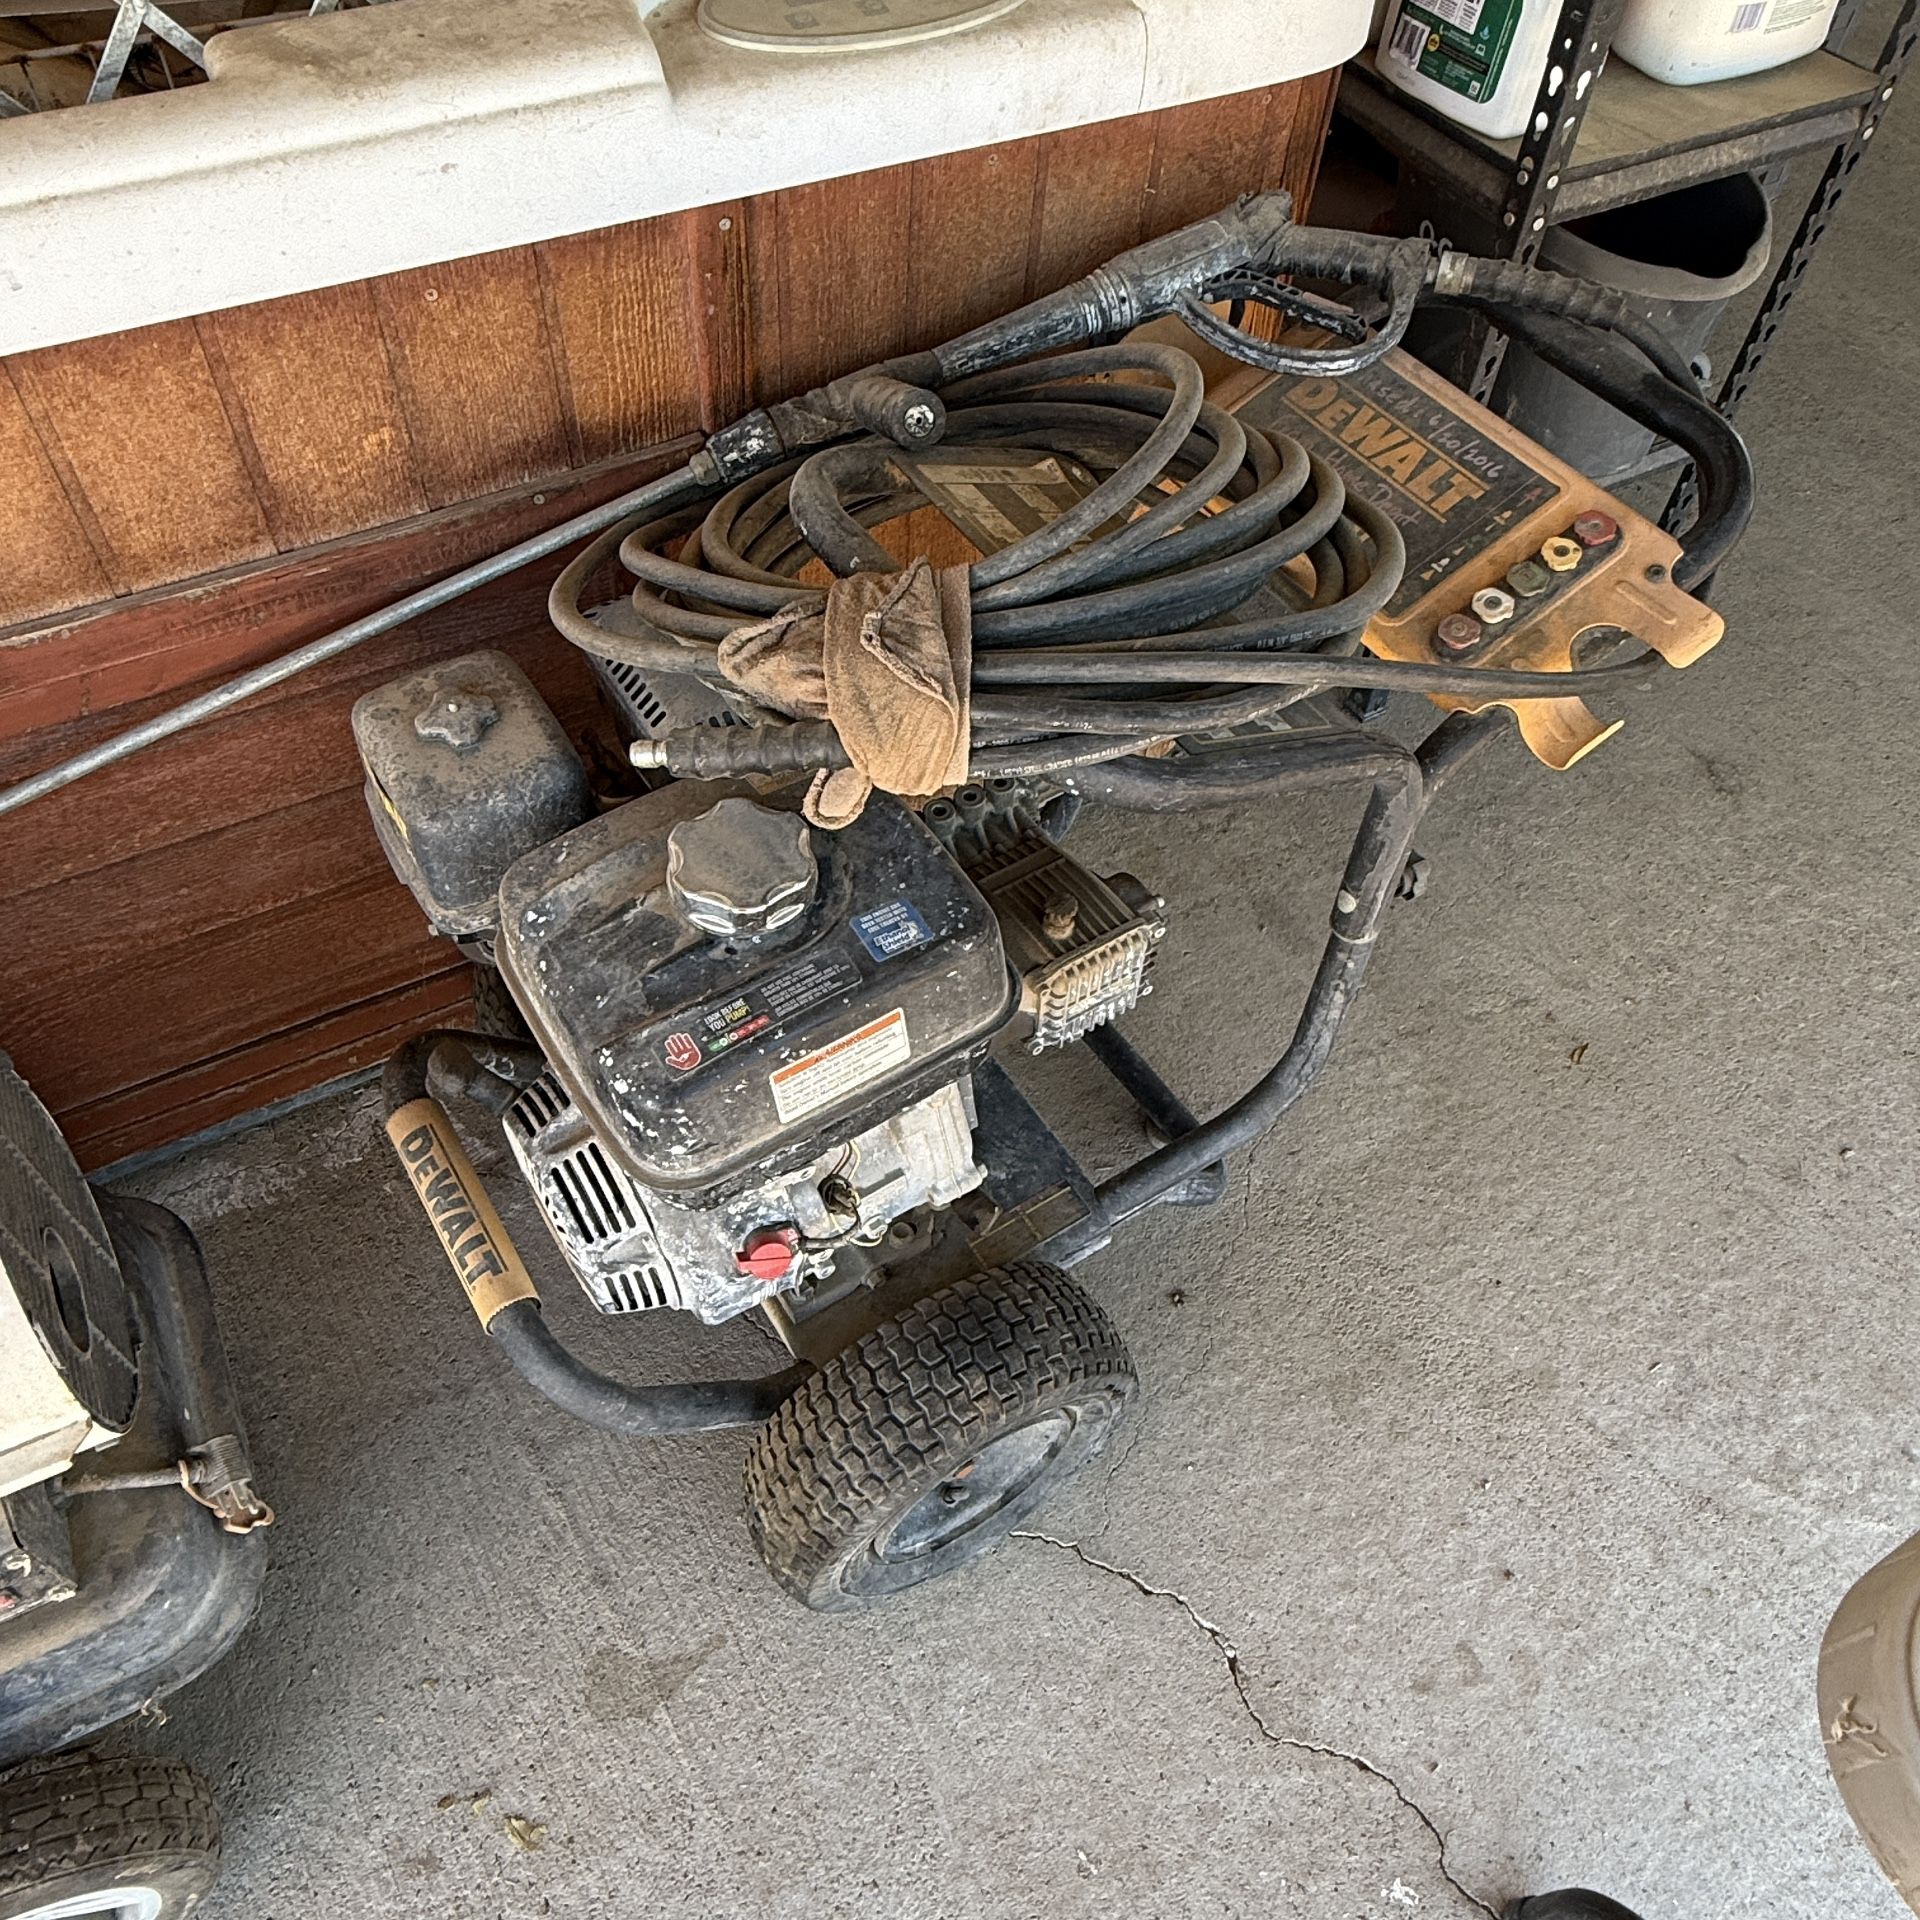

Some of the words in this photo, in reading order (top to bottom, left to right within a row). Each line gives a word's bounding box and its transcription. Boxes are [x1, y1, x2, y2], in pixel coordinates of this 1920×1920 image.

[875, 925, 911, 945] Ethanol
[882, 934, 910, 951] Shield
[703, 1008, 722, 1025] LOOK
[721, 998, 746, 1017] BEFORE
[708, 1015, 727, 1032] YOU
[724, 1004, 751, 1023] PUMP!
